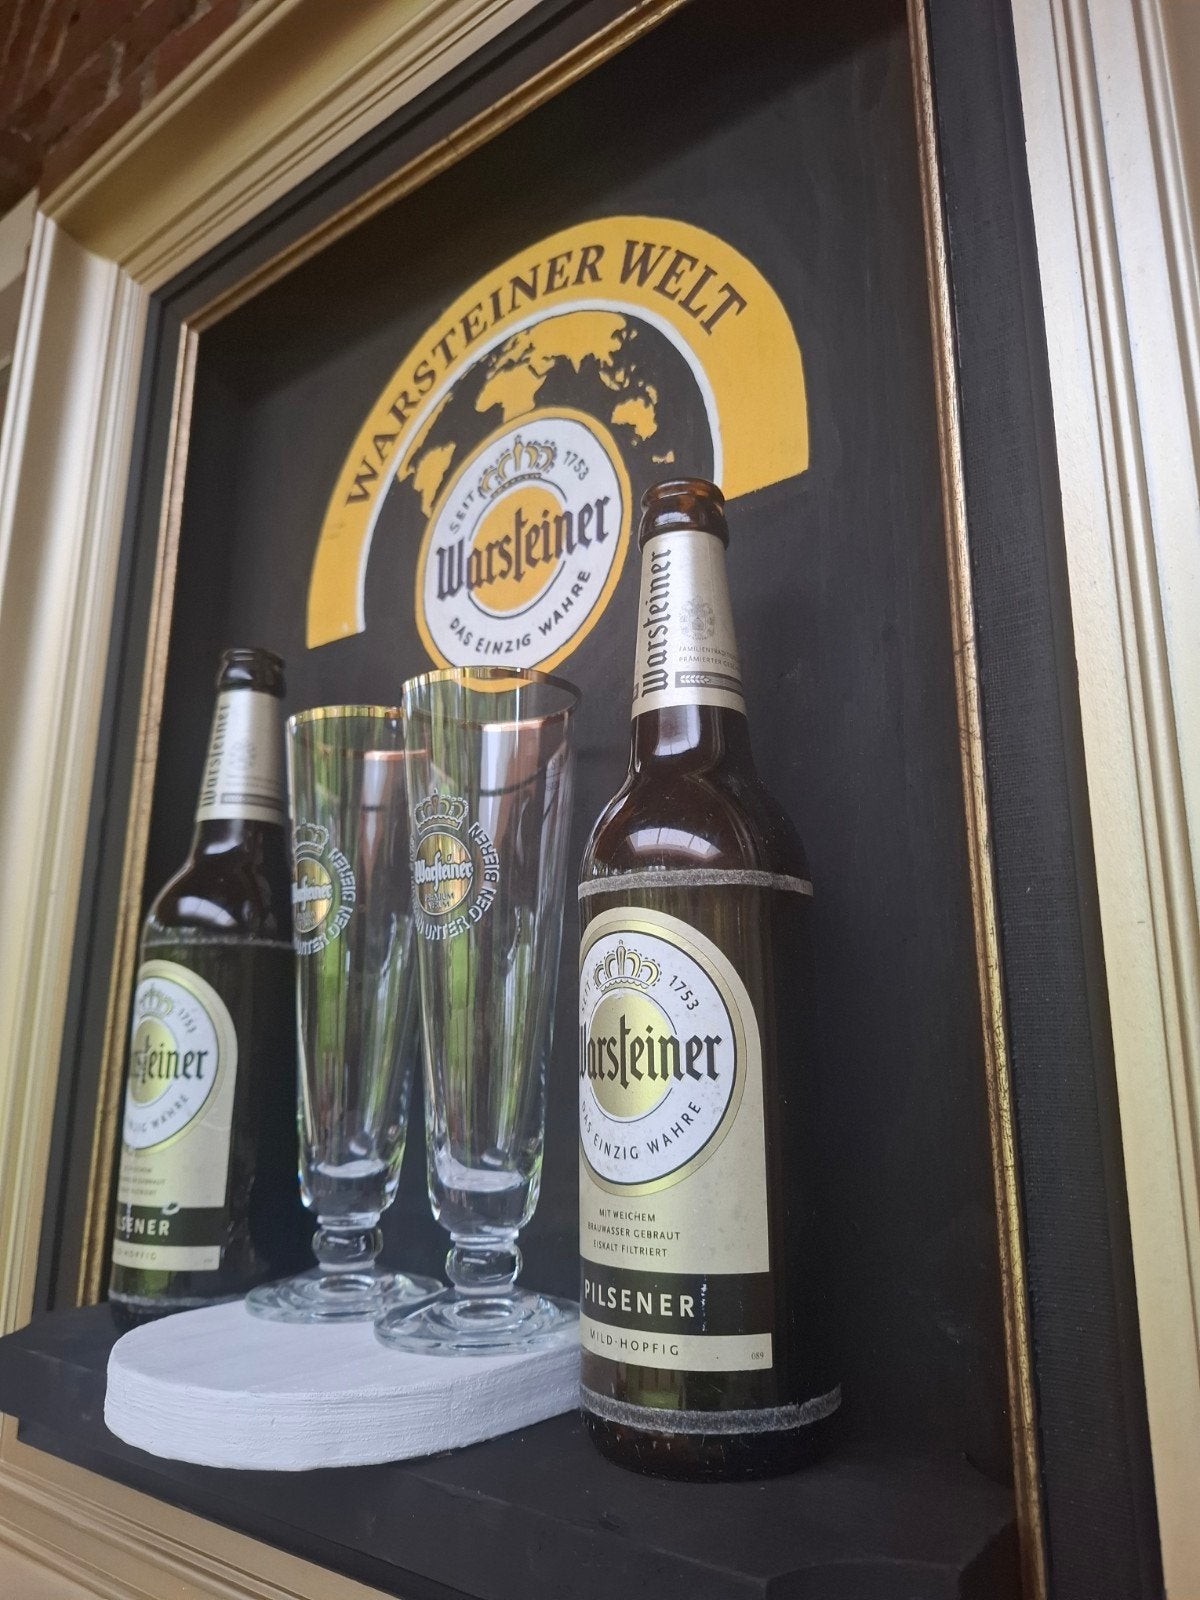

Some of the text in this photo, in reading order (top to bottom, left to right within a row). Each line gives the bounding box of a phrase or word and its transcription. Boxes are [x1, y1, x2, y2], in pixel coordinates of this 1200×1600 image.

[345, 239, 748, 507] WARSTEINER WELT
[449, 450, 590, 534] SEIT 1753
[436, 495, 611, 601] Warsteiner
[449, 569, 592, 655] DAS EINZIG WAHRE
[641, 549, 672, 698] Warsteiner
[467, 821, 500, 883] BIEREN
[468, 885, 497, 922] DEN
[669, 974, 700, 1011] 1753
[593, 1132, 639, 1160] EINZIG
[645, 1101, 702, 1154] WAHRE
[587, 1221, 681, 1241] BRAUWASSER GEBRAUT
[599, 1207, 656, 1222] MIT WEICHEM
[593, 1239, 668, 1258] EISKALT FILTRIERT
[584, 1278, 696, 1319] PILSENER
